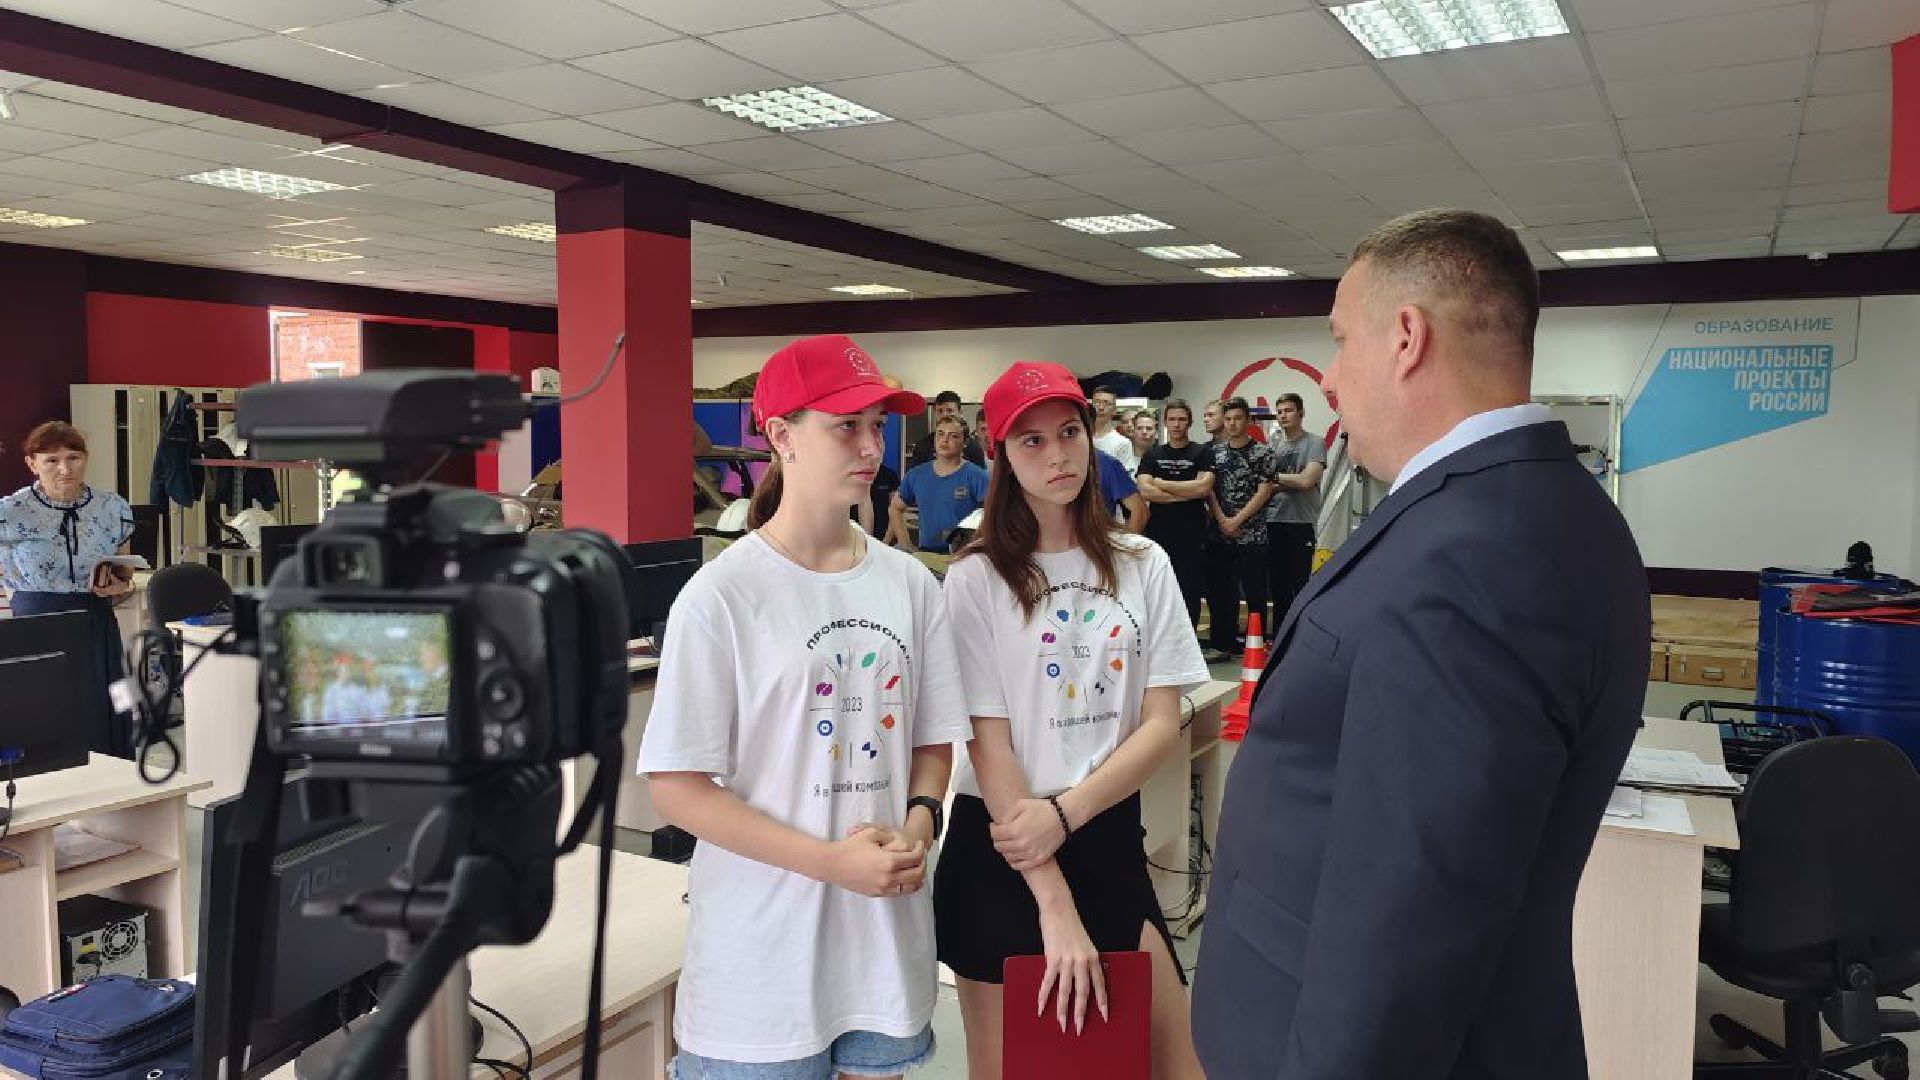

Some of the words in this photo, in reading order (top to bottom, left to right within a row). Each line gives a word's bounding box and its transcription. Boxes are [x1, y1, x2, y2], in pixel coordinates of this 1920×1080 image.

[1694, 317, 1834, 334] ОБРАЗОВАНИЕ
[1670, 348, 1828, 371] НАЦИОНАЛЬНЫЕ
[1735, 369, 1826, 389] ПРОЕКТЫ
[1750, 392, 1824, 412] РОССИИ
[841, 697, 863, 712] 2023
